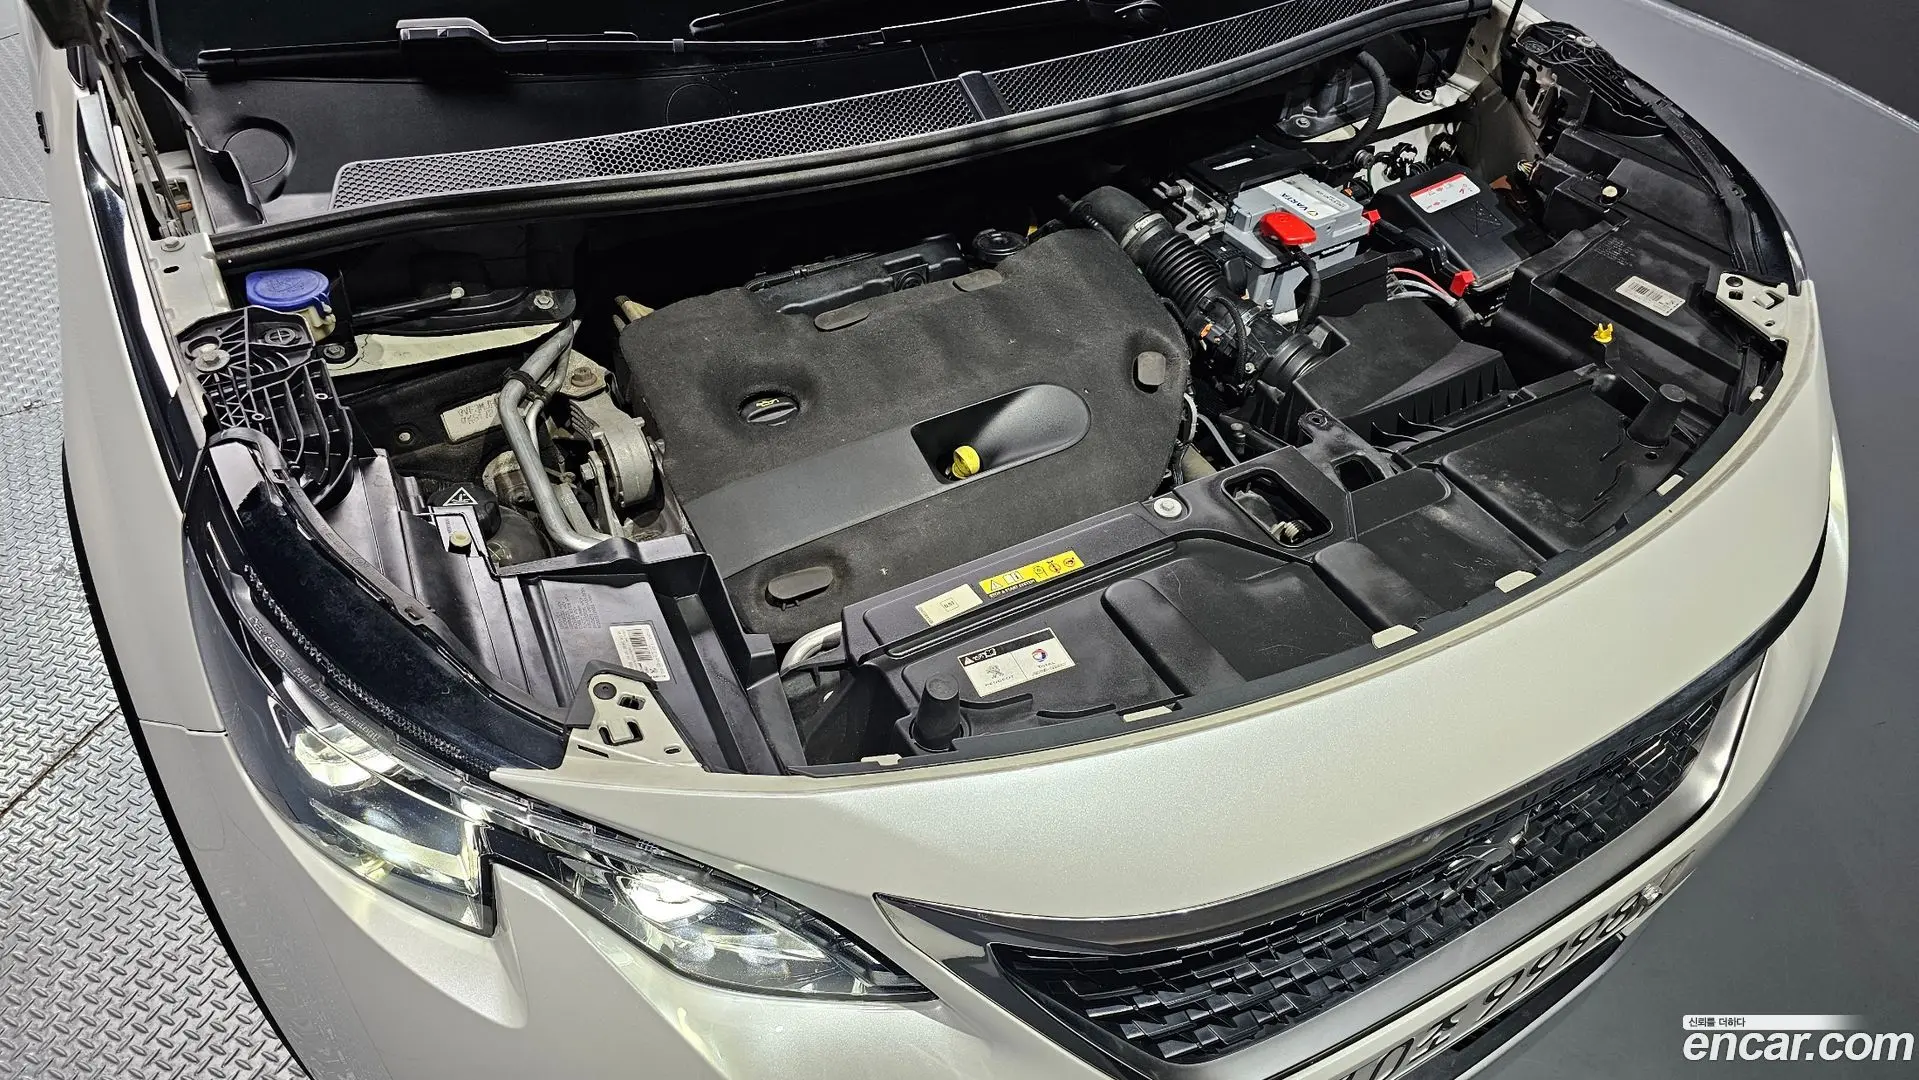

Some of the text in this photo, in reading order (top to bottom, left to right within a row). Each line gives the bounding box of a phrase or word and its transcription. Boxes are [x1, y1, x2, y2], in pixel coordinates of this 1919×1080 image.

[1281, 193, 1308, 211] VARTA
[250, 615, 292, 664] PEUGEOT
[1464, 734, 1641, 839] PEUGEOT
